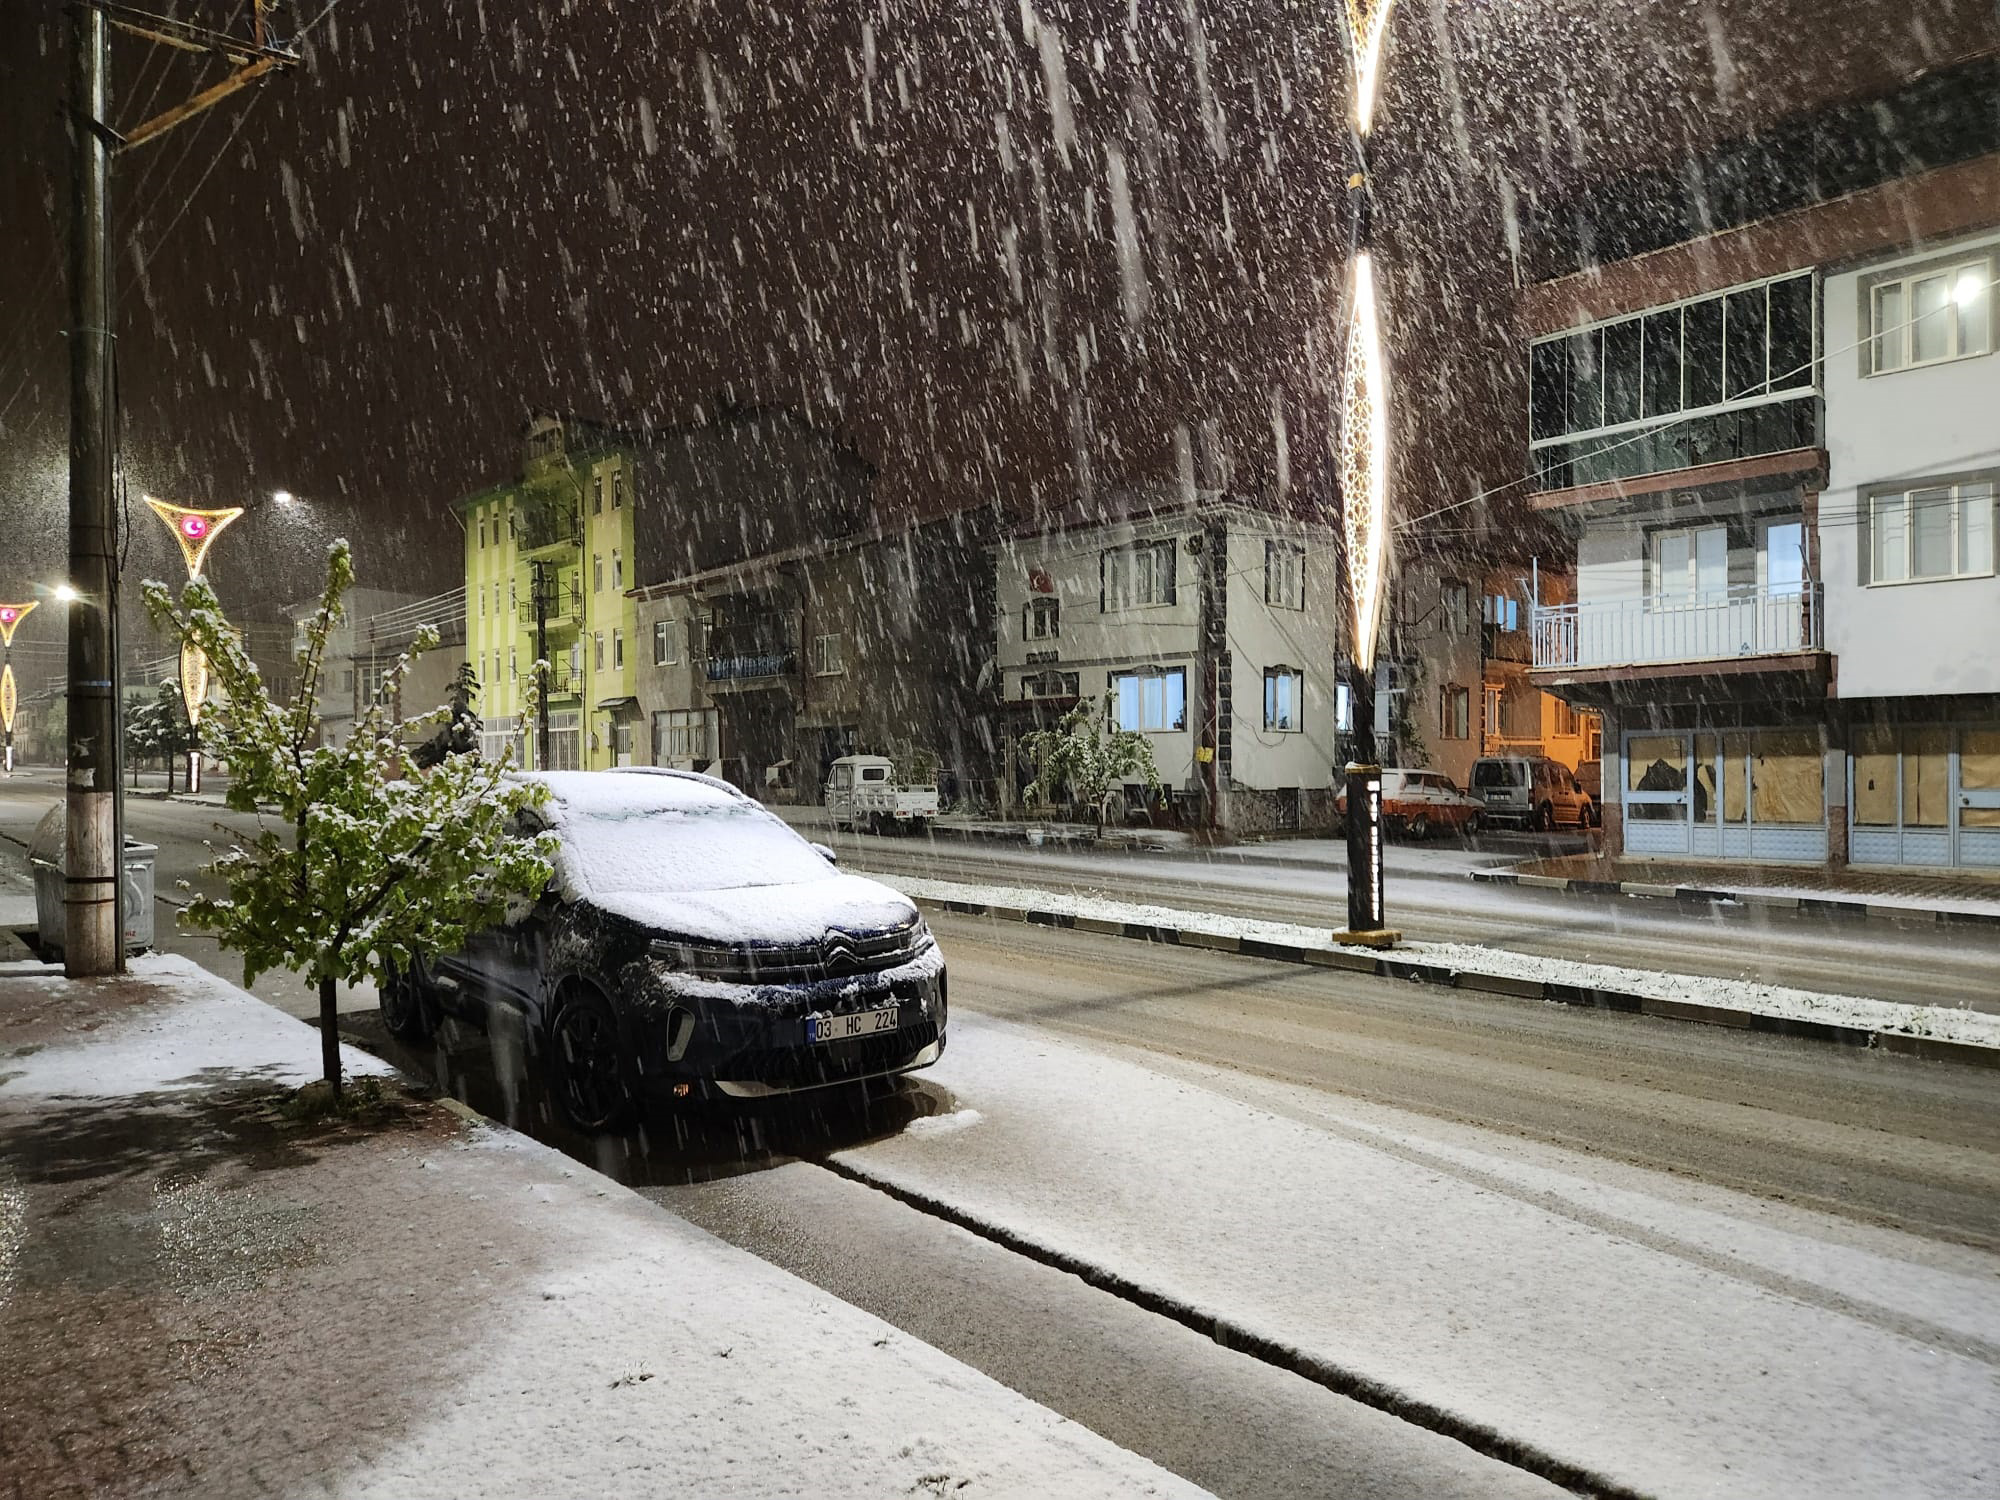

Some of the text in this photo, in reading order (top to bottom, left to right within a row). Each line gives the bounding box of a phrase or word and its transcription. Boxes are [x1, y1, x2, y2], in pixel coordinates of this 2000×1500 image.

[816, 1010, 896, 1038] 03 HC 224
